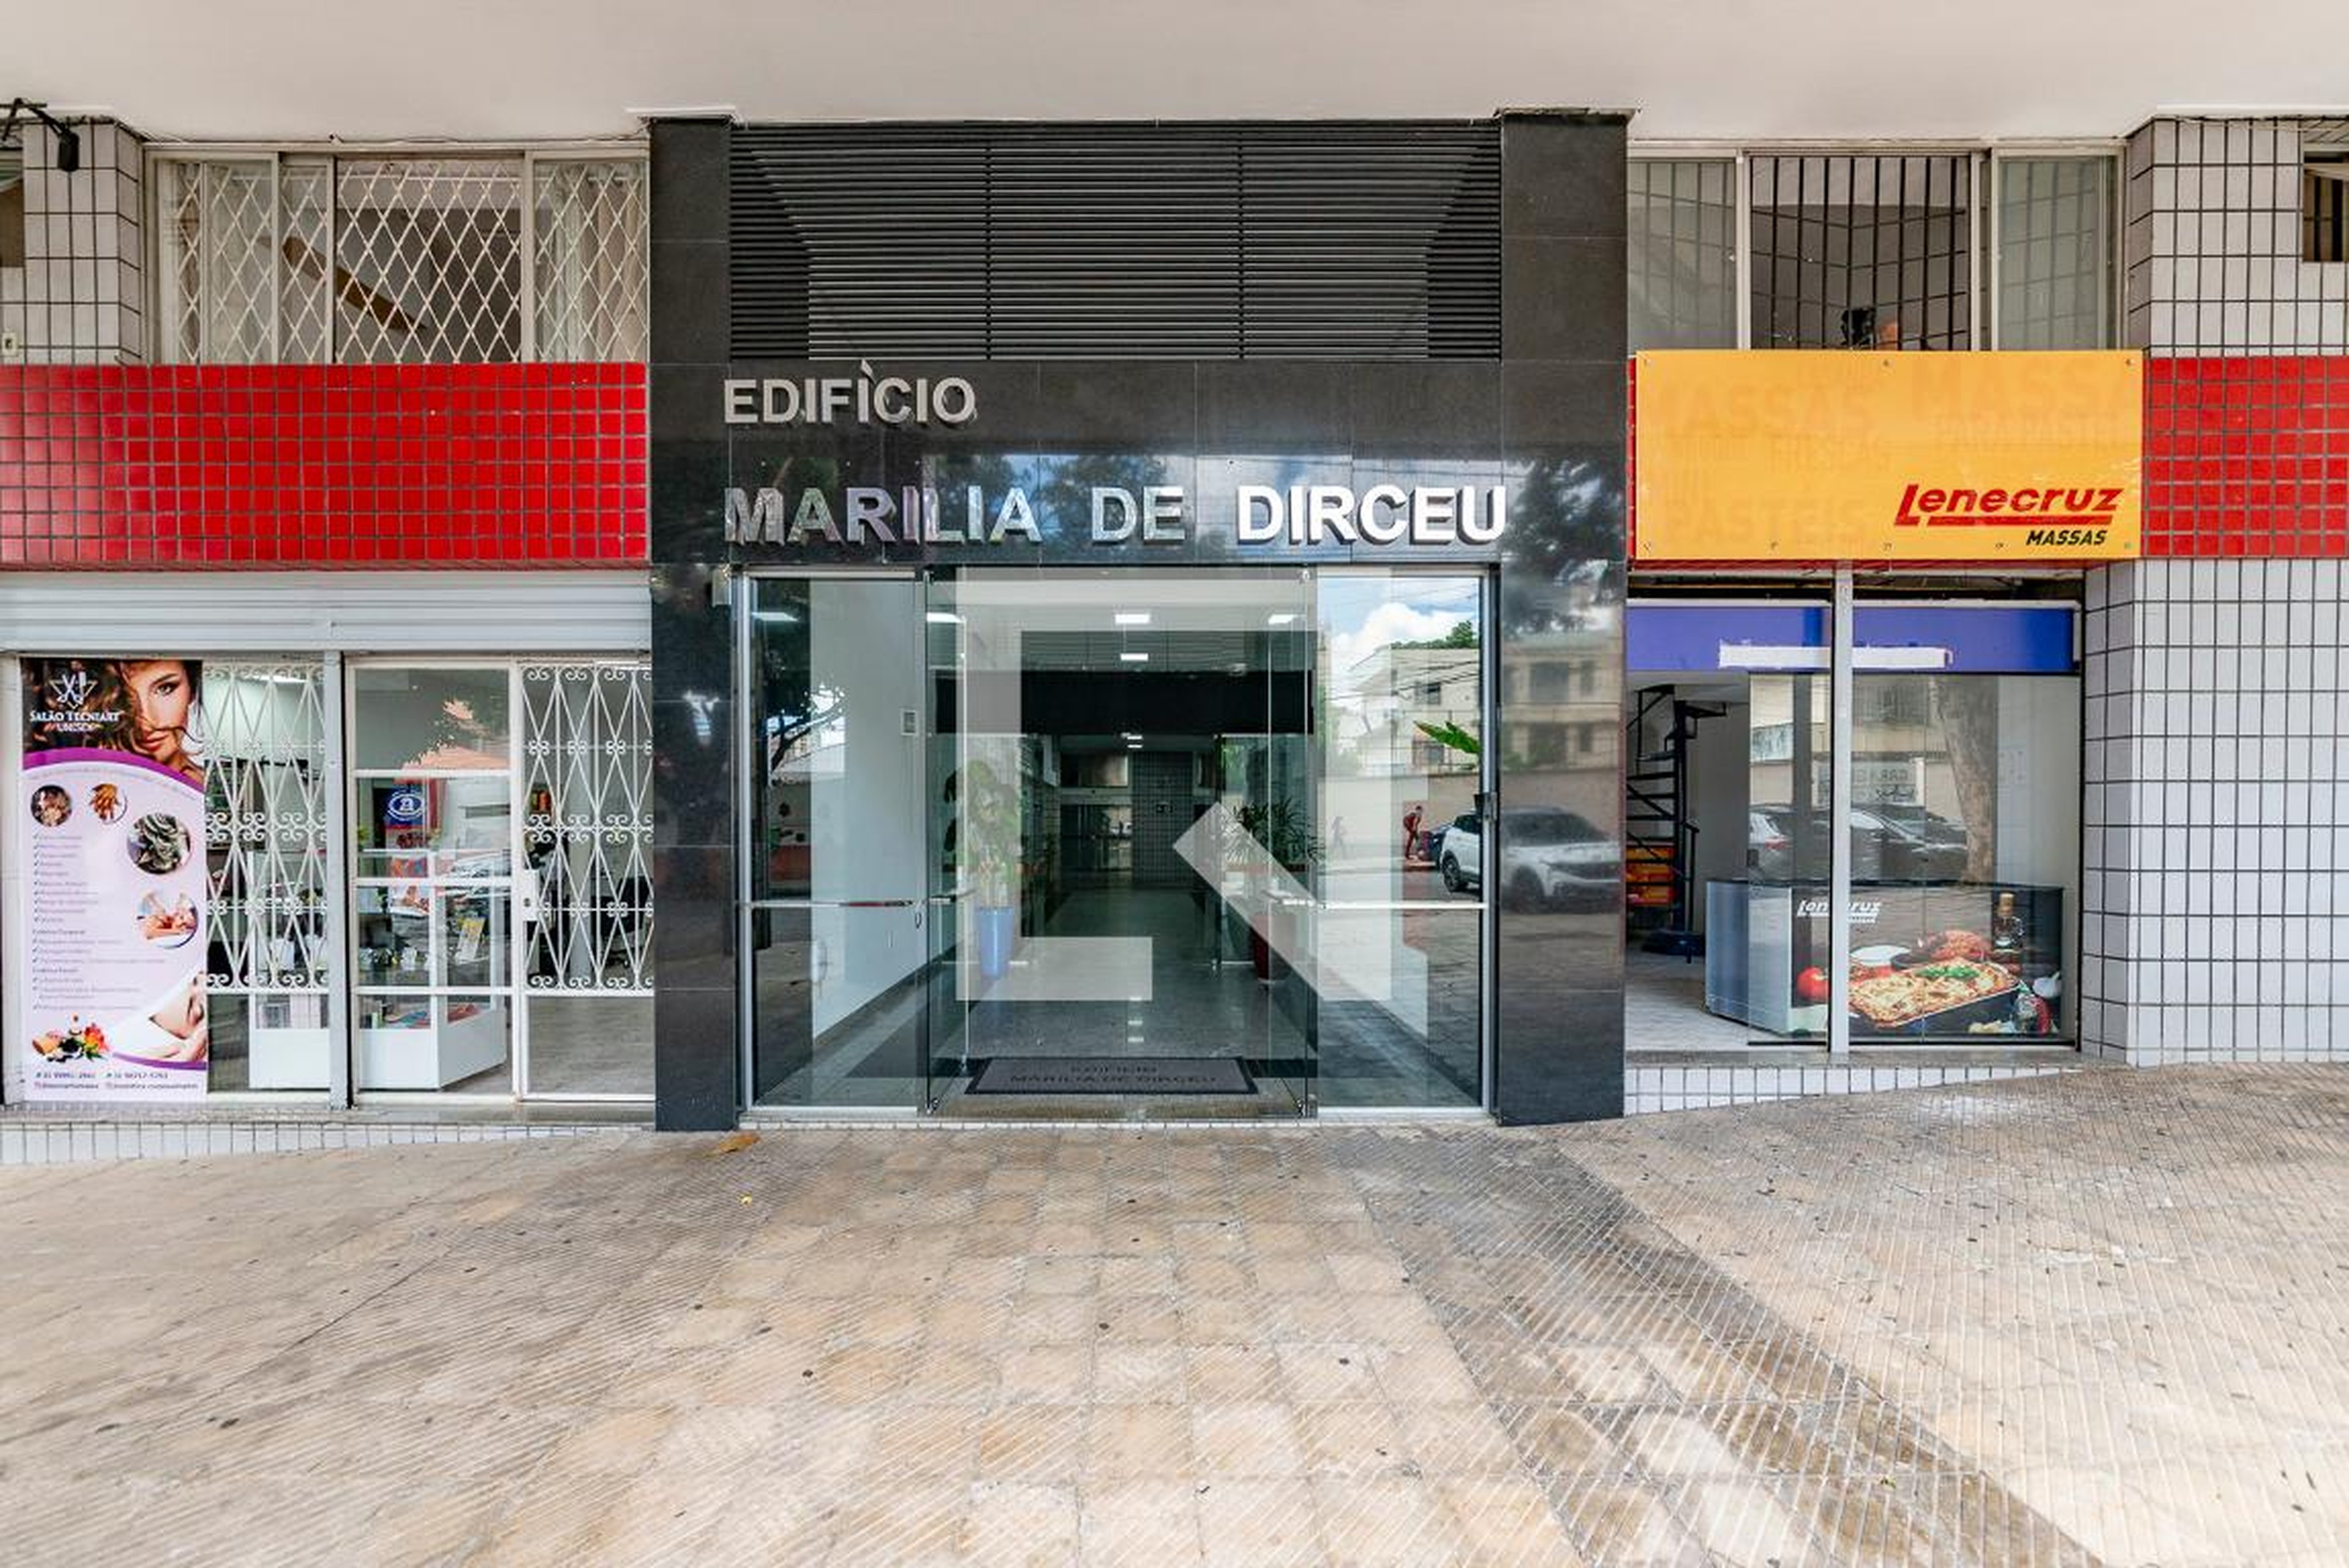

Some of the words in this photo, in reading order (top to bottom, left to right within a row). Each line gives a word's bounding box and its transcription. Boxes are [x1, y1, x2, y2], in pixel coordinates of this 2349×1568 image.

[724, 487, 1044, 546] MARILIA
[1091, 487, 1186, 544] DE
[1236, 485, 1507, 544] DIRCEU
[1894, 484, 2124, 527] Lenecruz
[2025, 529, 2108, 546] MASSAS
[1797, 899, 1881, 917] Lenruz
